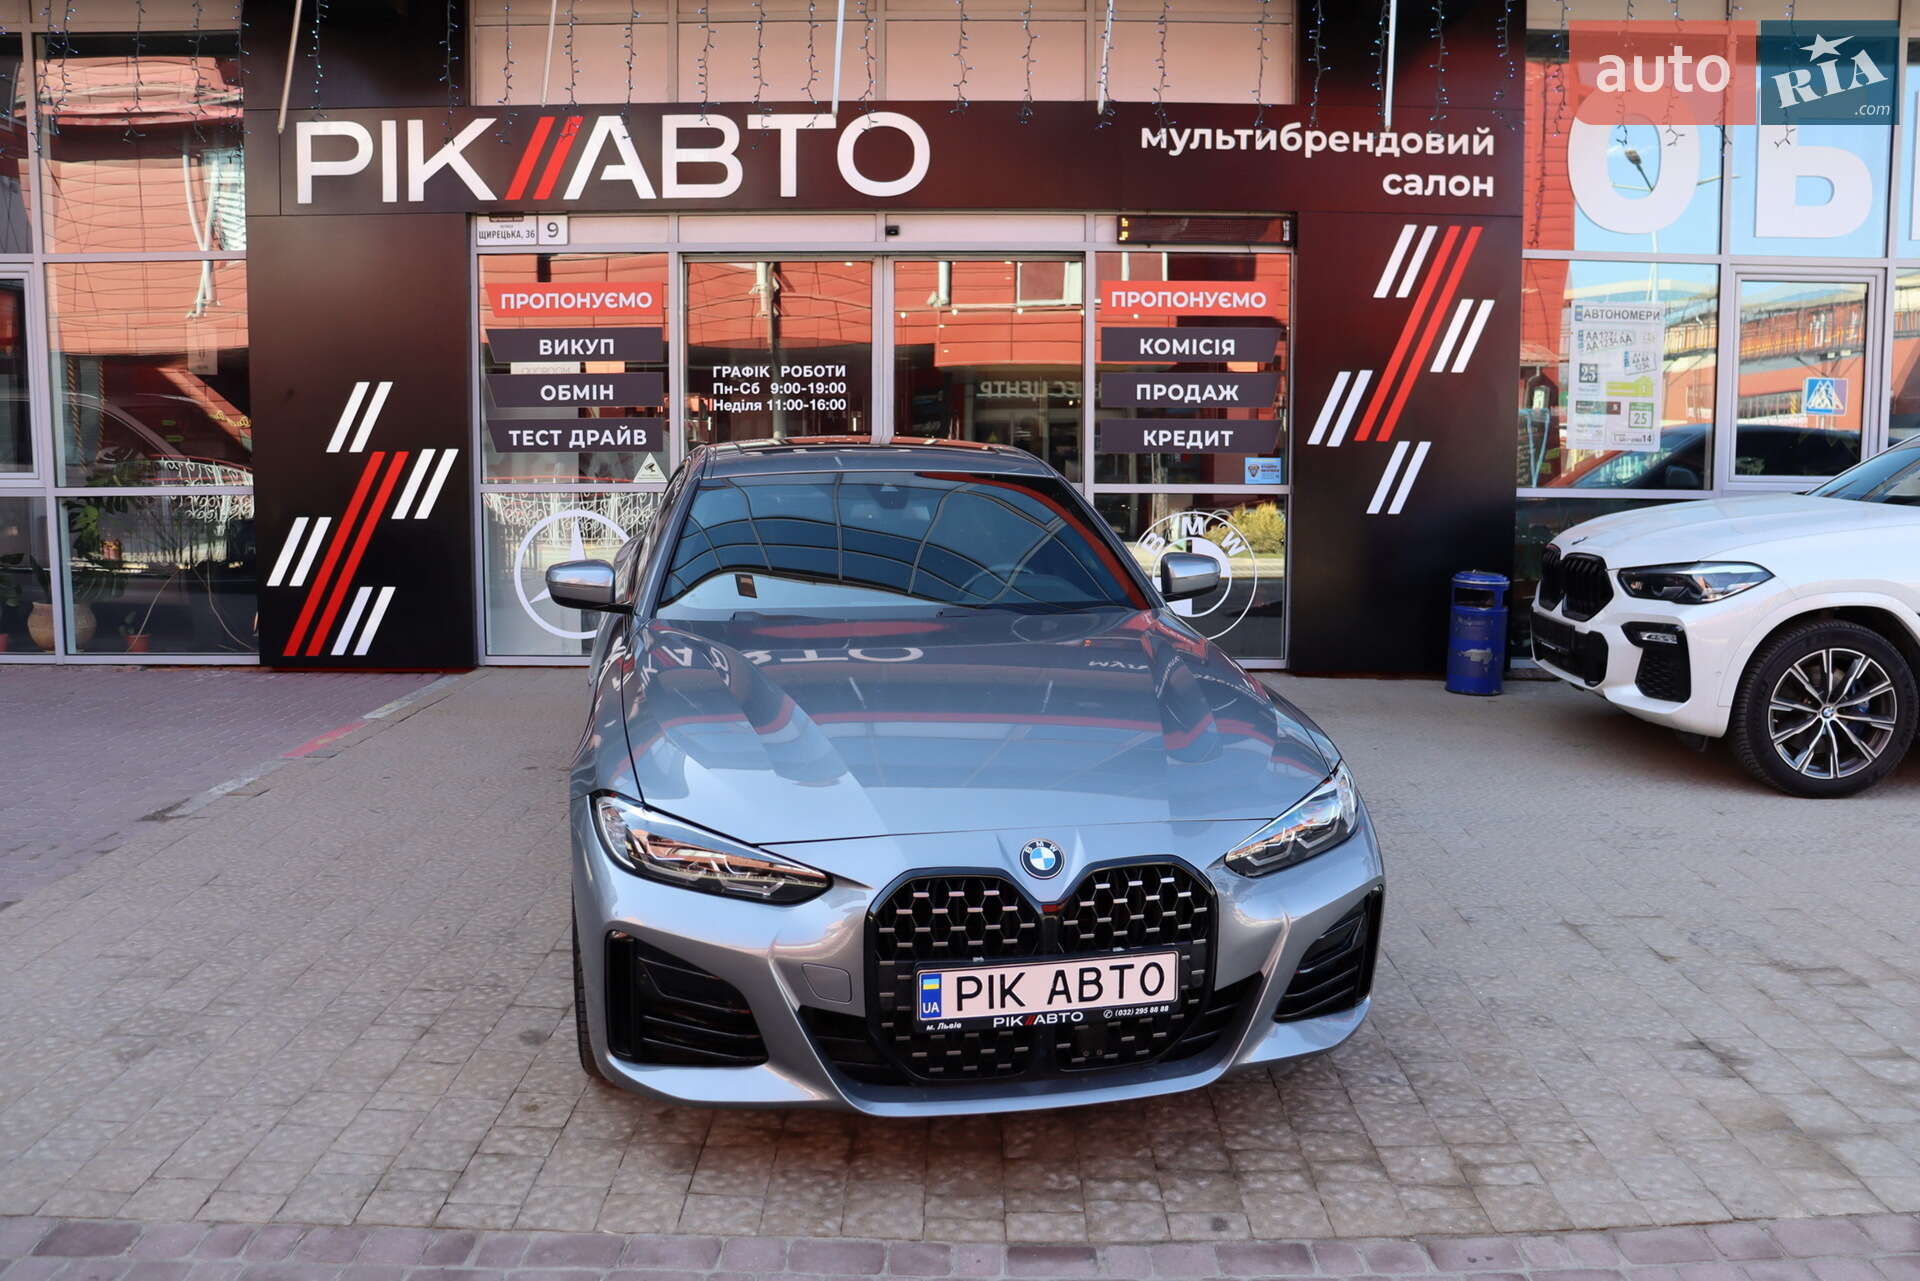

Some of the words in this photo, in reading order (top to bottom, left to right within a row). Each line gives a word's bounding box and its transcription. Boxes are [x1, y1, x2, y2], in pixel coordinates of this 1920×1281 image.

[1141, 122, 1495, 158] мультибрендовий
[563, 111, 931, 199] АВТО
[1382, 173, 1495, 197] салон
[478, 230, 524, 240] ЩИРЕЦЬКА,
[526, 230, 535, 239] 36
[546, 222, 559, 238] 9
[501, 292, 653, 309] ПРОПОНУЄМО
[1111, 291, 1267, 308] ПРОПОНУЄМО
[1584, 309, 1661, 321] АВТОНОМЕРИ
[539, 338, 615, 355] ВИКУП
[1139, 338, 1236, 355] КОМІСІЯ
[713, 365, 770, 378] ГРАФІК
[781, 365, 846, 378] РОБОТИ
[540, 384, 614, 401] ОБМІН
[713, 382, 760, 395] Пн-Сб
[770, 382, 847, 394] 9:00-19:00
[1136, 384, 1239, 403] ПРОДАЖ
[713, 399, 762, 413] Неділя
[767, 399, 847, 411] 11:00-16:00
[1634, 413, 1647, 424] 25
[508, 429, 562, 446] ТЕСТ
[569, 425, 647, 449] ДРАЙВ
[1143, 430, 1234, 449] КРЕДИТ
[1143, 516, 1248, 556] BMW
[1024, 841, 1058, 854] BMW
[957, 972, 1026, 1011] РІК
[1047, 962, 1165, 1005] АВТО
[922, 1000, 939, 1014] UA
[1115, 1008, 1134, 1017] (032)
[1135, 1007, 1148, 1015] 295
